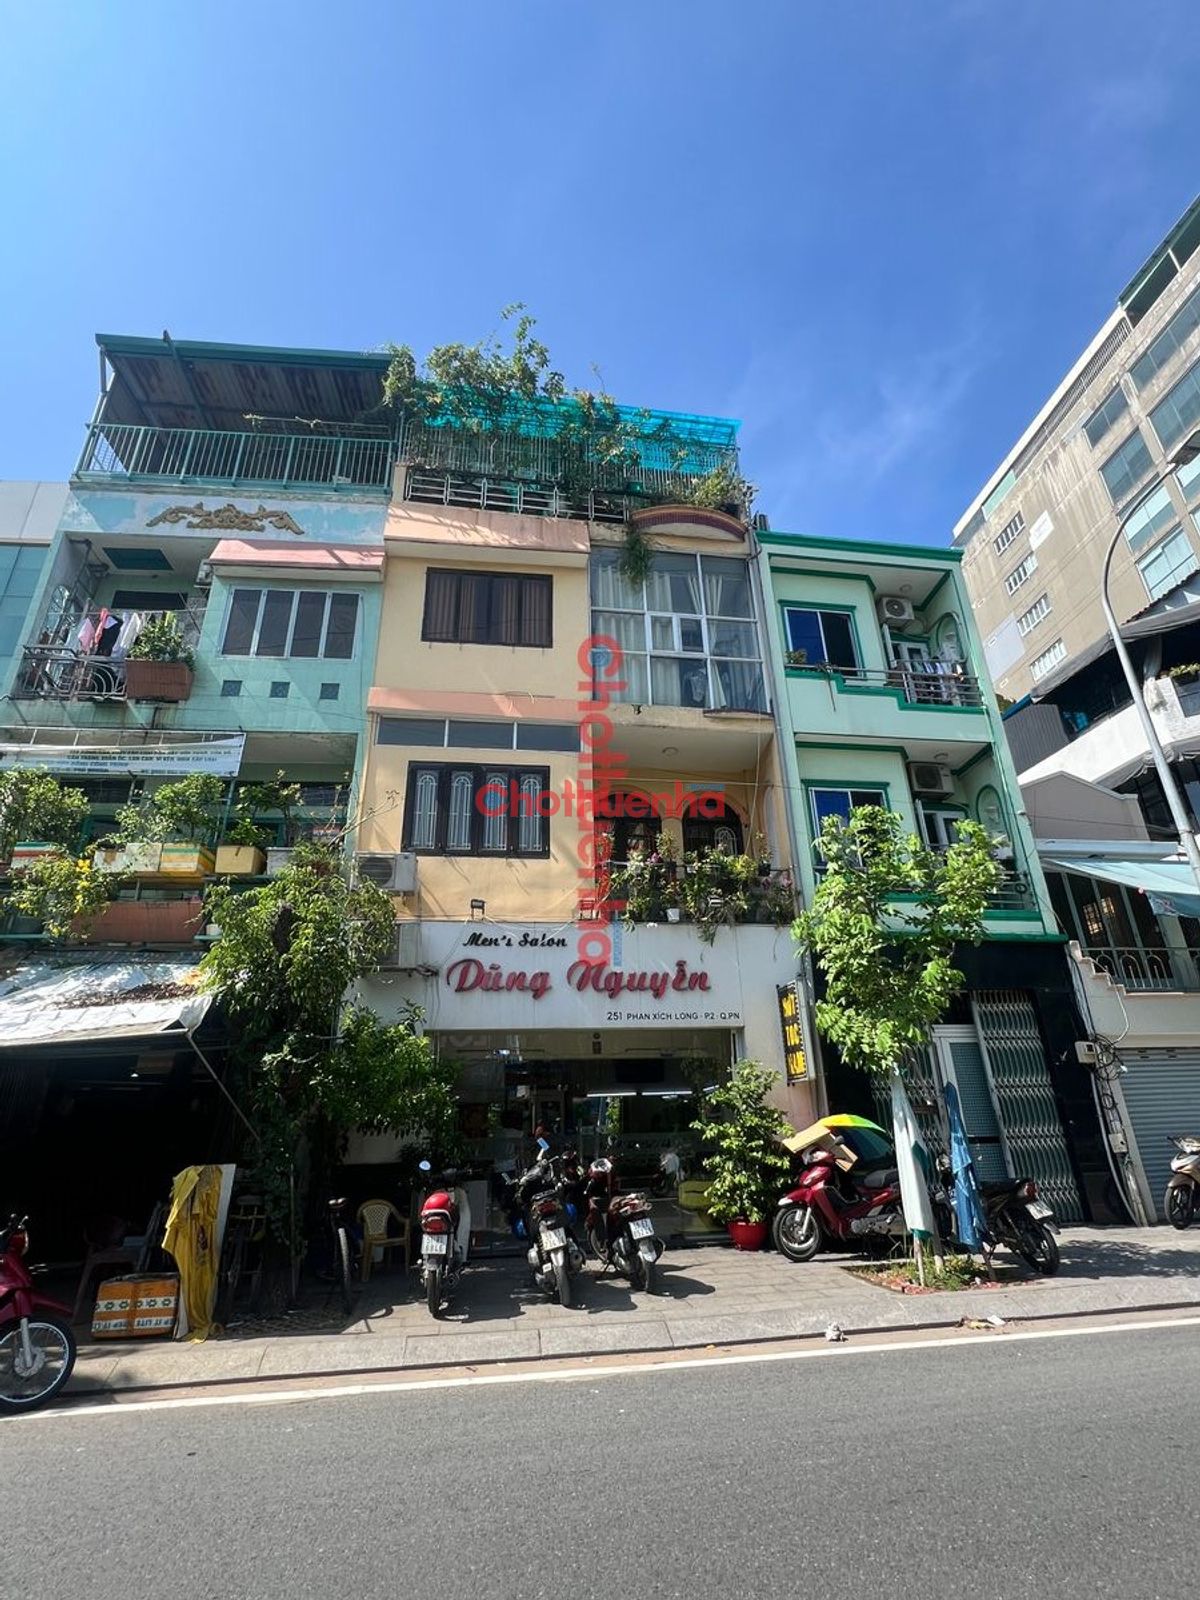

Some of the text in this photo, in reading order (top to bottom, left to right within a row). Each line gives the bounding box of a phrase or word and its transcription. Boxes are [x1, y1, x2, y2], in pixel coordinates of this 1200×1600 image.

[463, 932, 567, 947] Men's Salon
[446, 958, 711, 1000] Dũng Nguyễn
[607, 1011, 623, 1021] 251
[626, 1012, 651, 1020] PHAN
[674, 1012, 699, 1020] LONG
